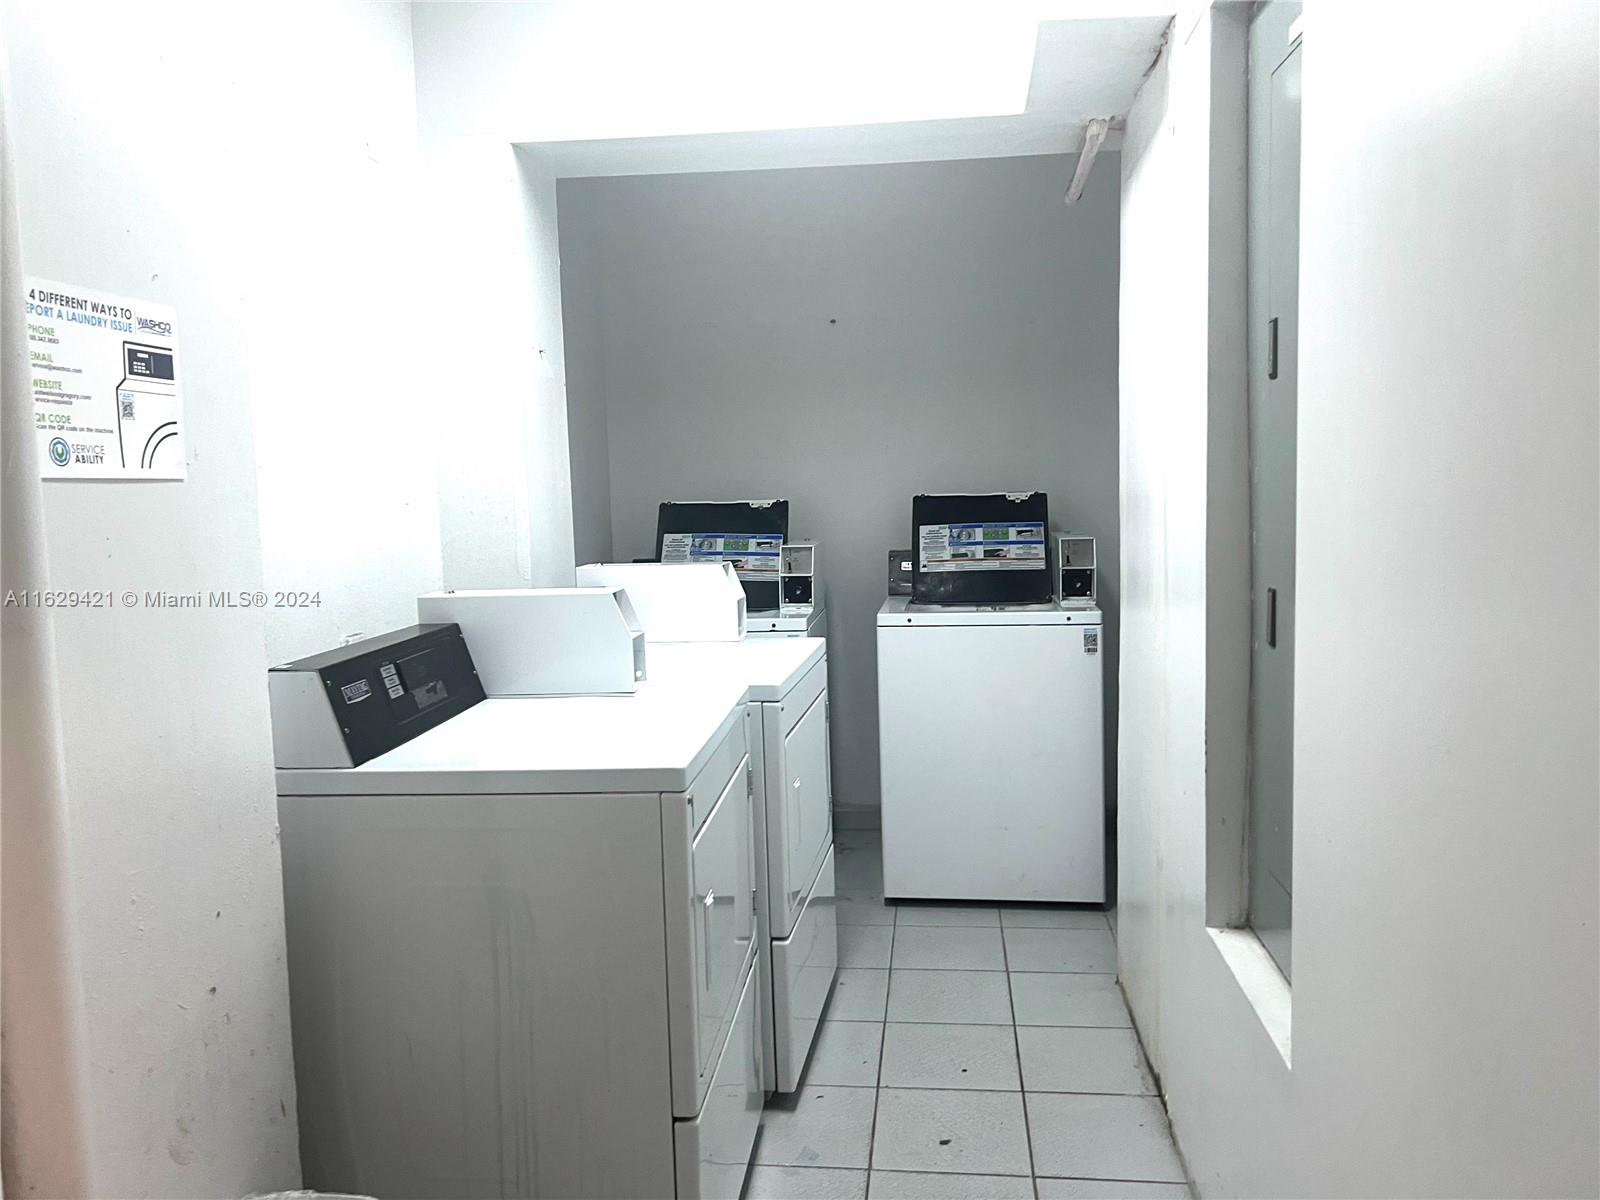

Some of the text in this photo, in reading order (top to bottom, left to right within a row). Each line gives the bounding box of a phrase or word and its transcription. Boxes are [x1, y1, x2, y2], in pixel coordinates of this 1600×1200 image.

[29, 288, 132, 320] 4 DIFFERENT WAYS TO
[26, 302, 133, 334] EPORT A LAUNDRY ISSUE
[136, 316, 172, 334] WASHCO
[30, 350, 54, 363] EMAIL
[33, 379, 63, 391] WEBSITE
[48, 413, 72, 425] CODE
[71, 443, 105, 455] SERVICE
[75, 454, 105, 465] ABILITY
